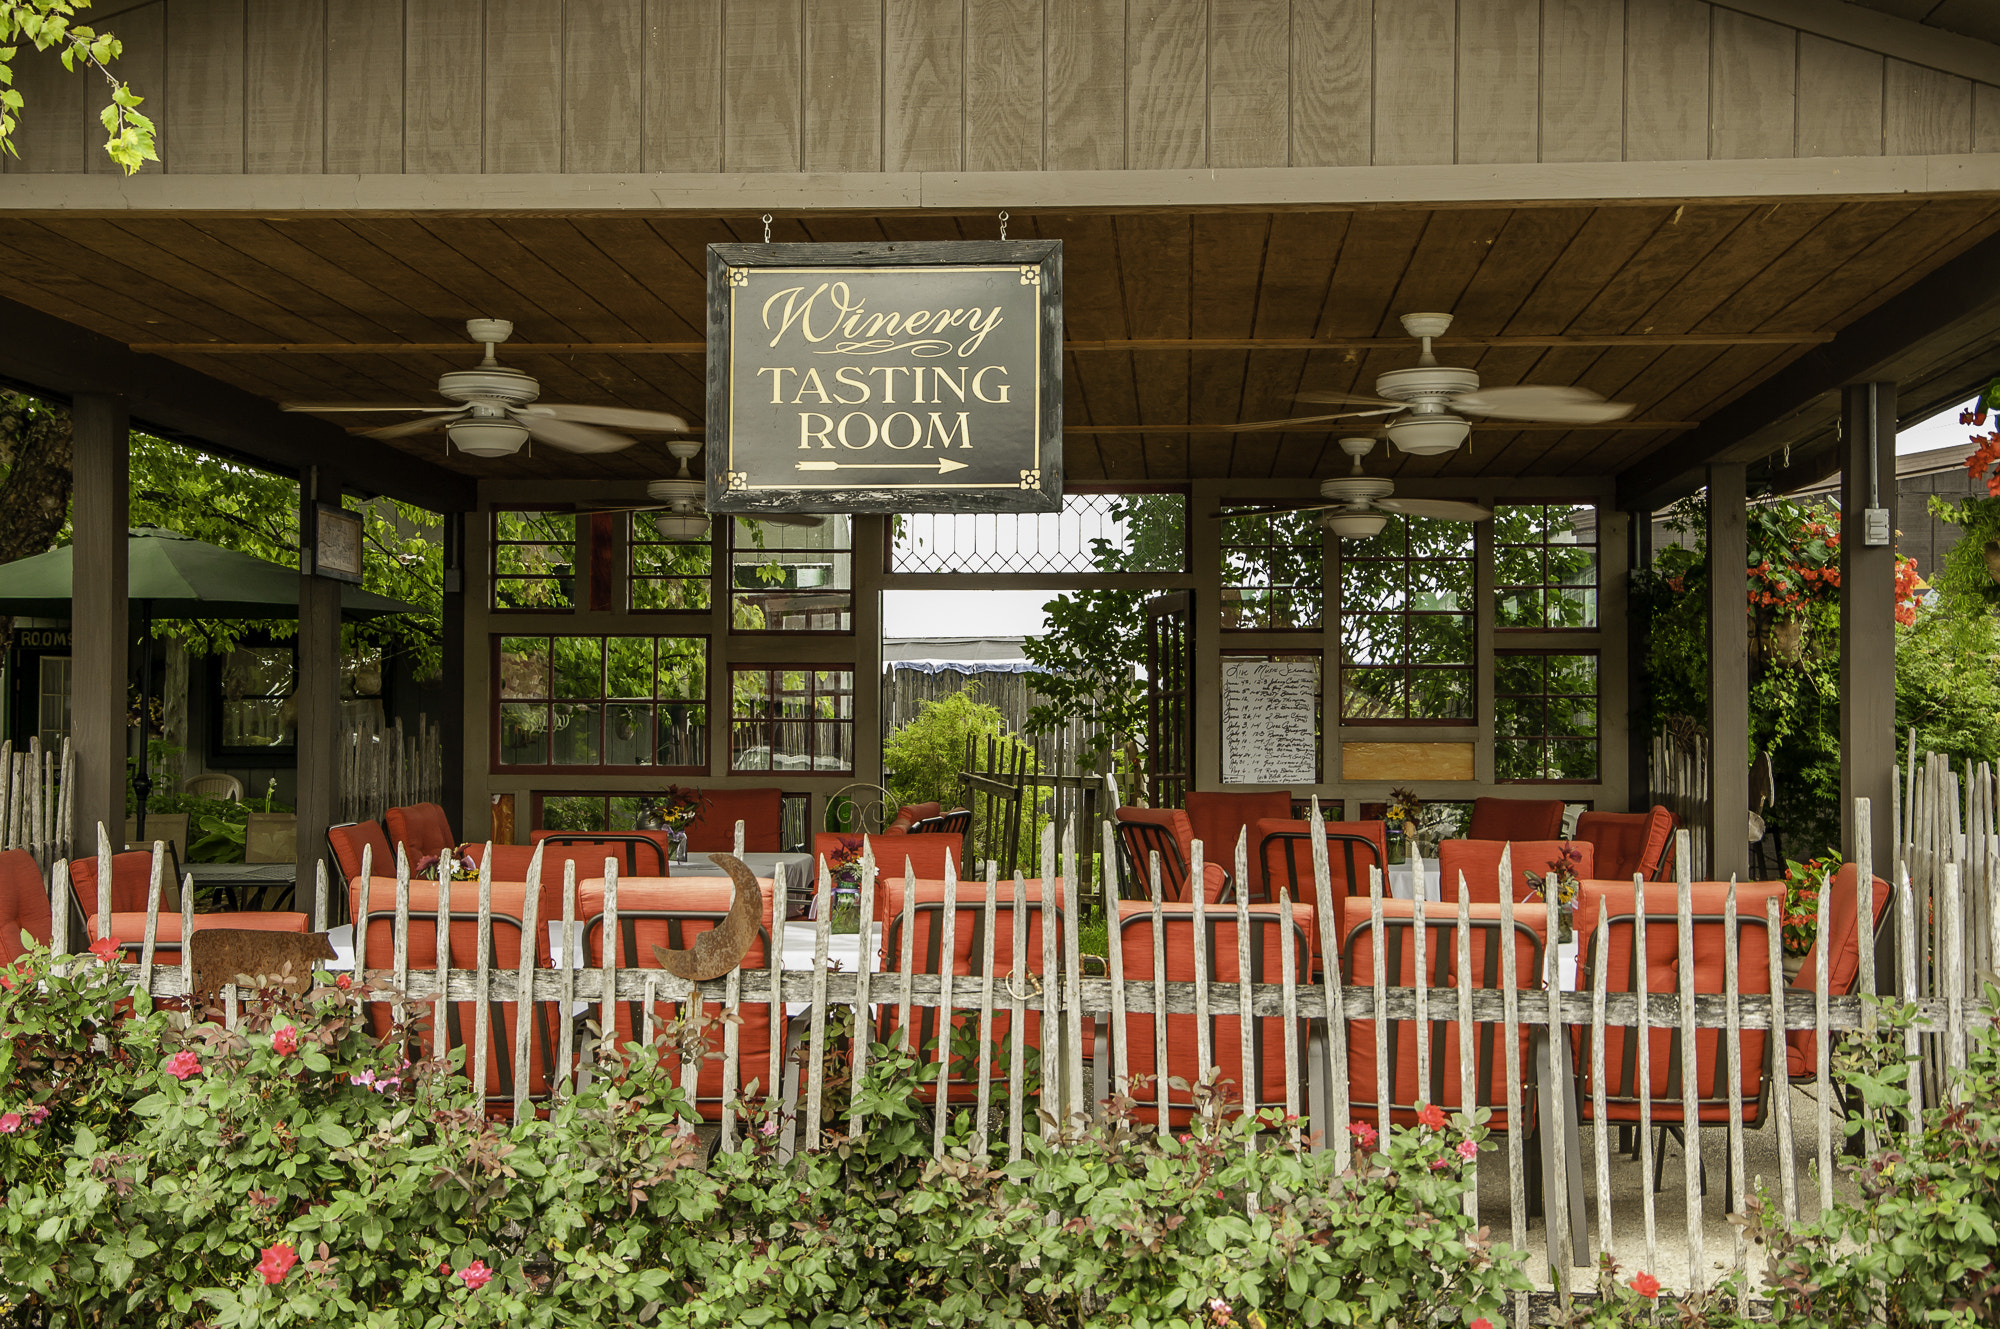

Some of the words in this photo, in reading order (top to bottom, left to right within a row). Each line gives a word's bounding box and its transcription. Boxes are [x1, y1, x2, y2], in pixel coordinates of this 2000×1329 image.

[762, 282, 1003, 358] Winery
[757, 366, 1011, 404] TASTING
[797, 412, 973, 449] ROOM
[1226, 663, 1249, 679] Live
[1254, 665, 1278, 680] Music
